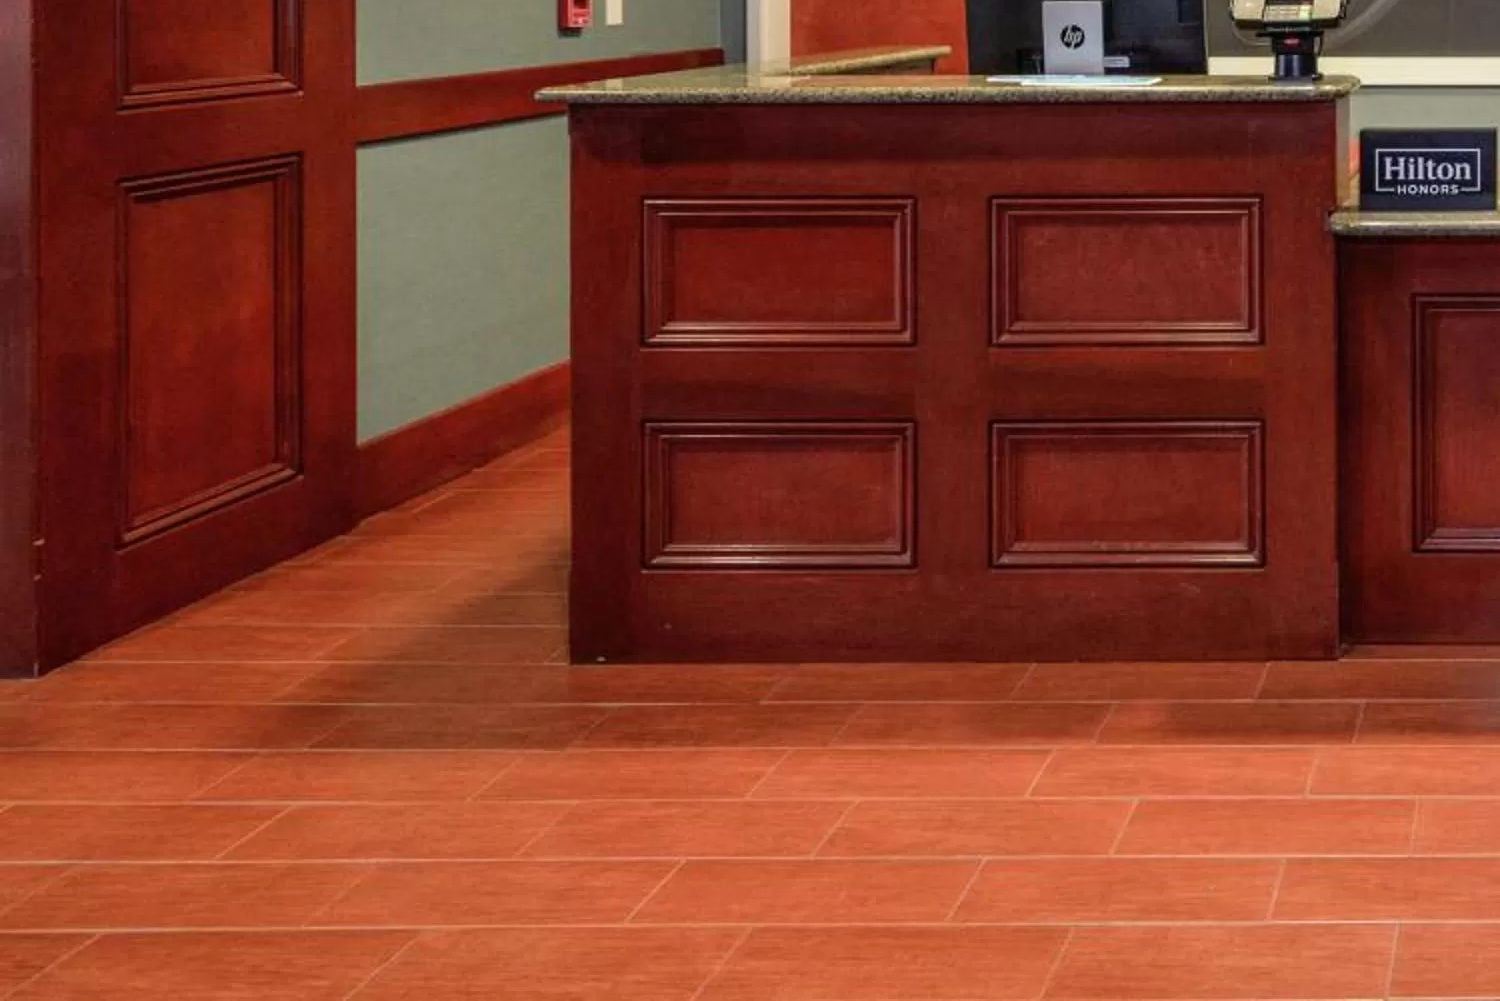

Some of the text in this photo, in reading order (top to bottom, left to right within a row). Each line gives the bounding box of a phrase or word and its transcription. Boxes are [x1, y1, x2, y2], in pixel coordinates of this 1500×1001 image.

[1061, 25, 1085, 49] hp
[1384, 156, 1472, 180] Hilton
[1397, 184, 1459, 195] HONORS
